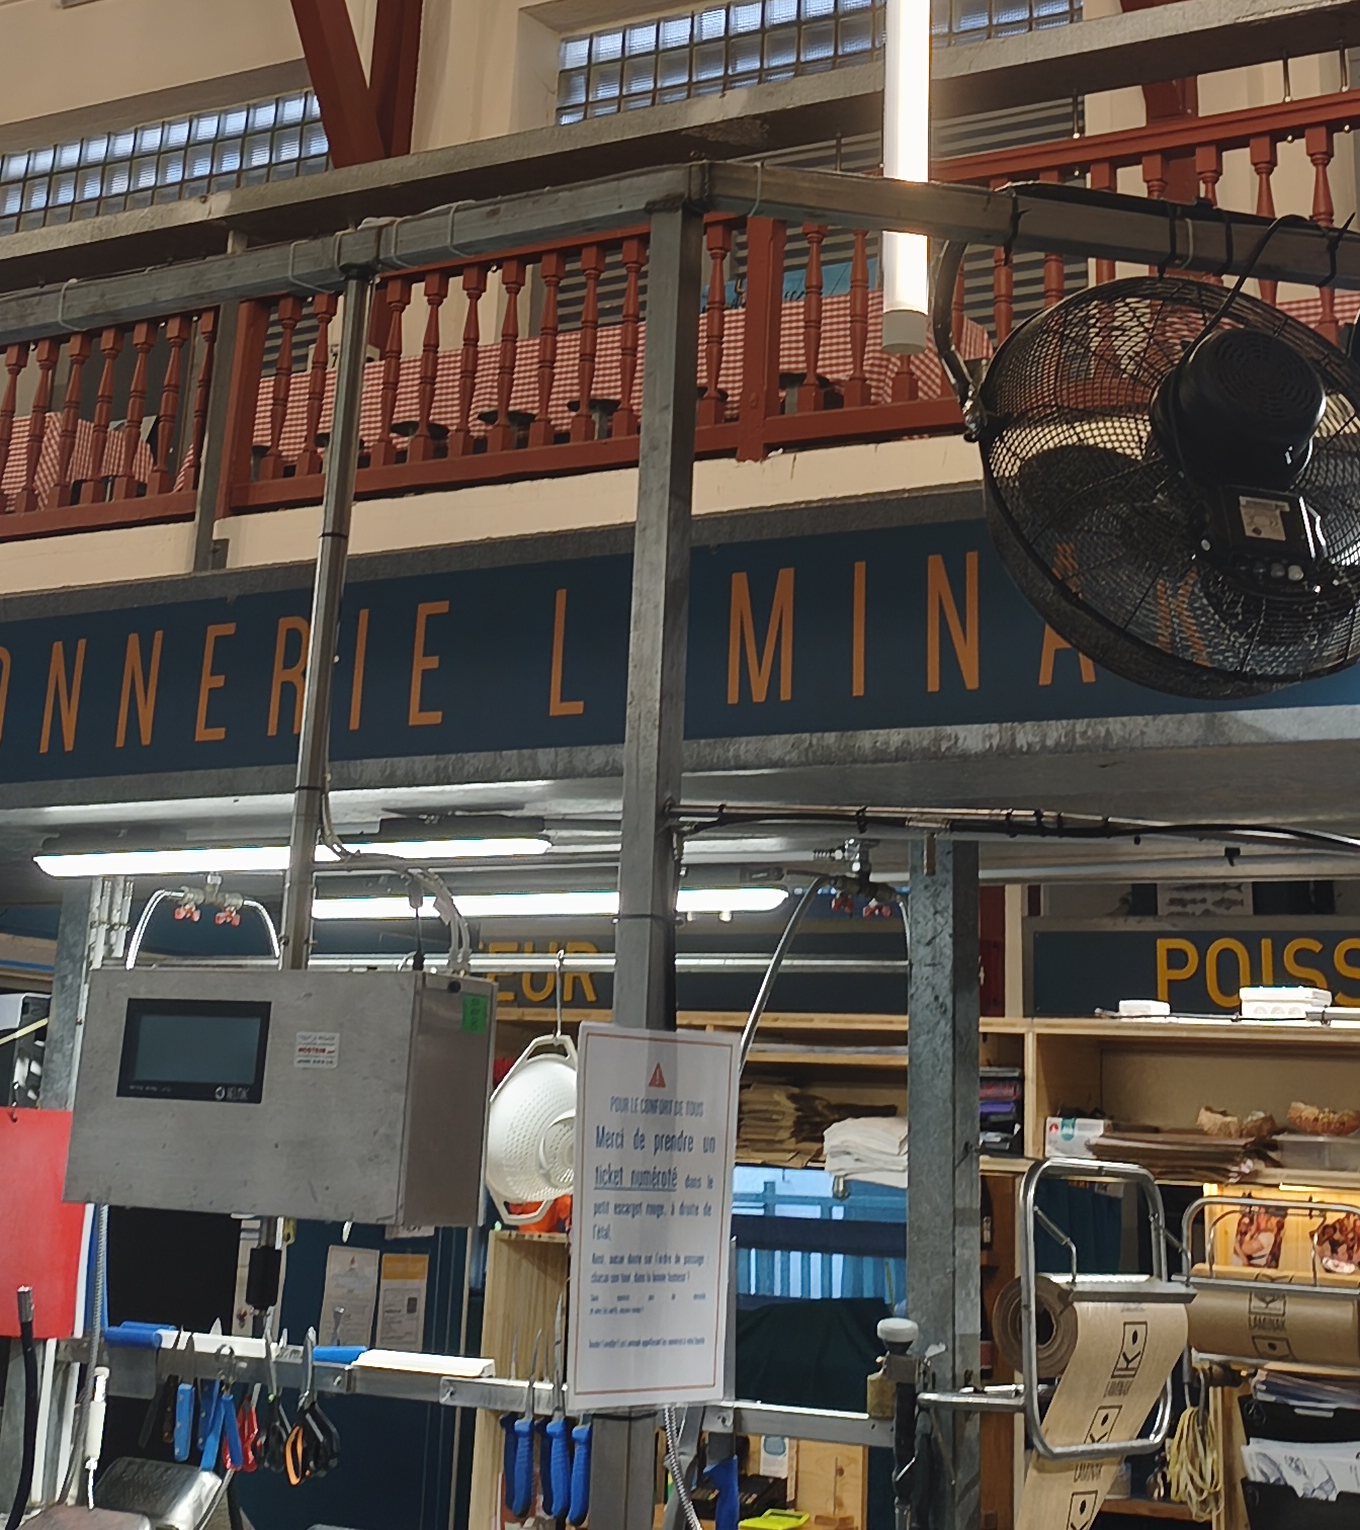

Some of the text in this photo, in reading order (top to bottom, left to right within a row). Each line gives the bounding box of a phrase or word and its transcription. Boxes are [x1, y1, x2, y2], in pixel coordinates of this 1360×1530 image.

[595, 1125, 716, 1157] Merci de prendre un
[594, 1163, 624, 1189] ticket
[630, 1165, 678, 1190] numéroté
